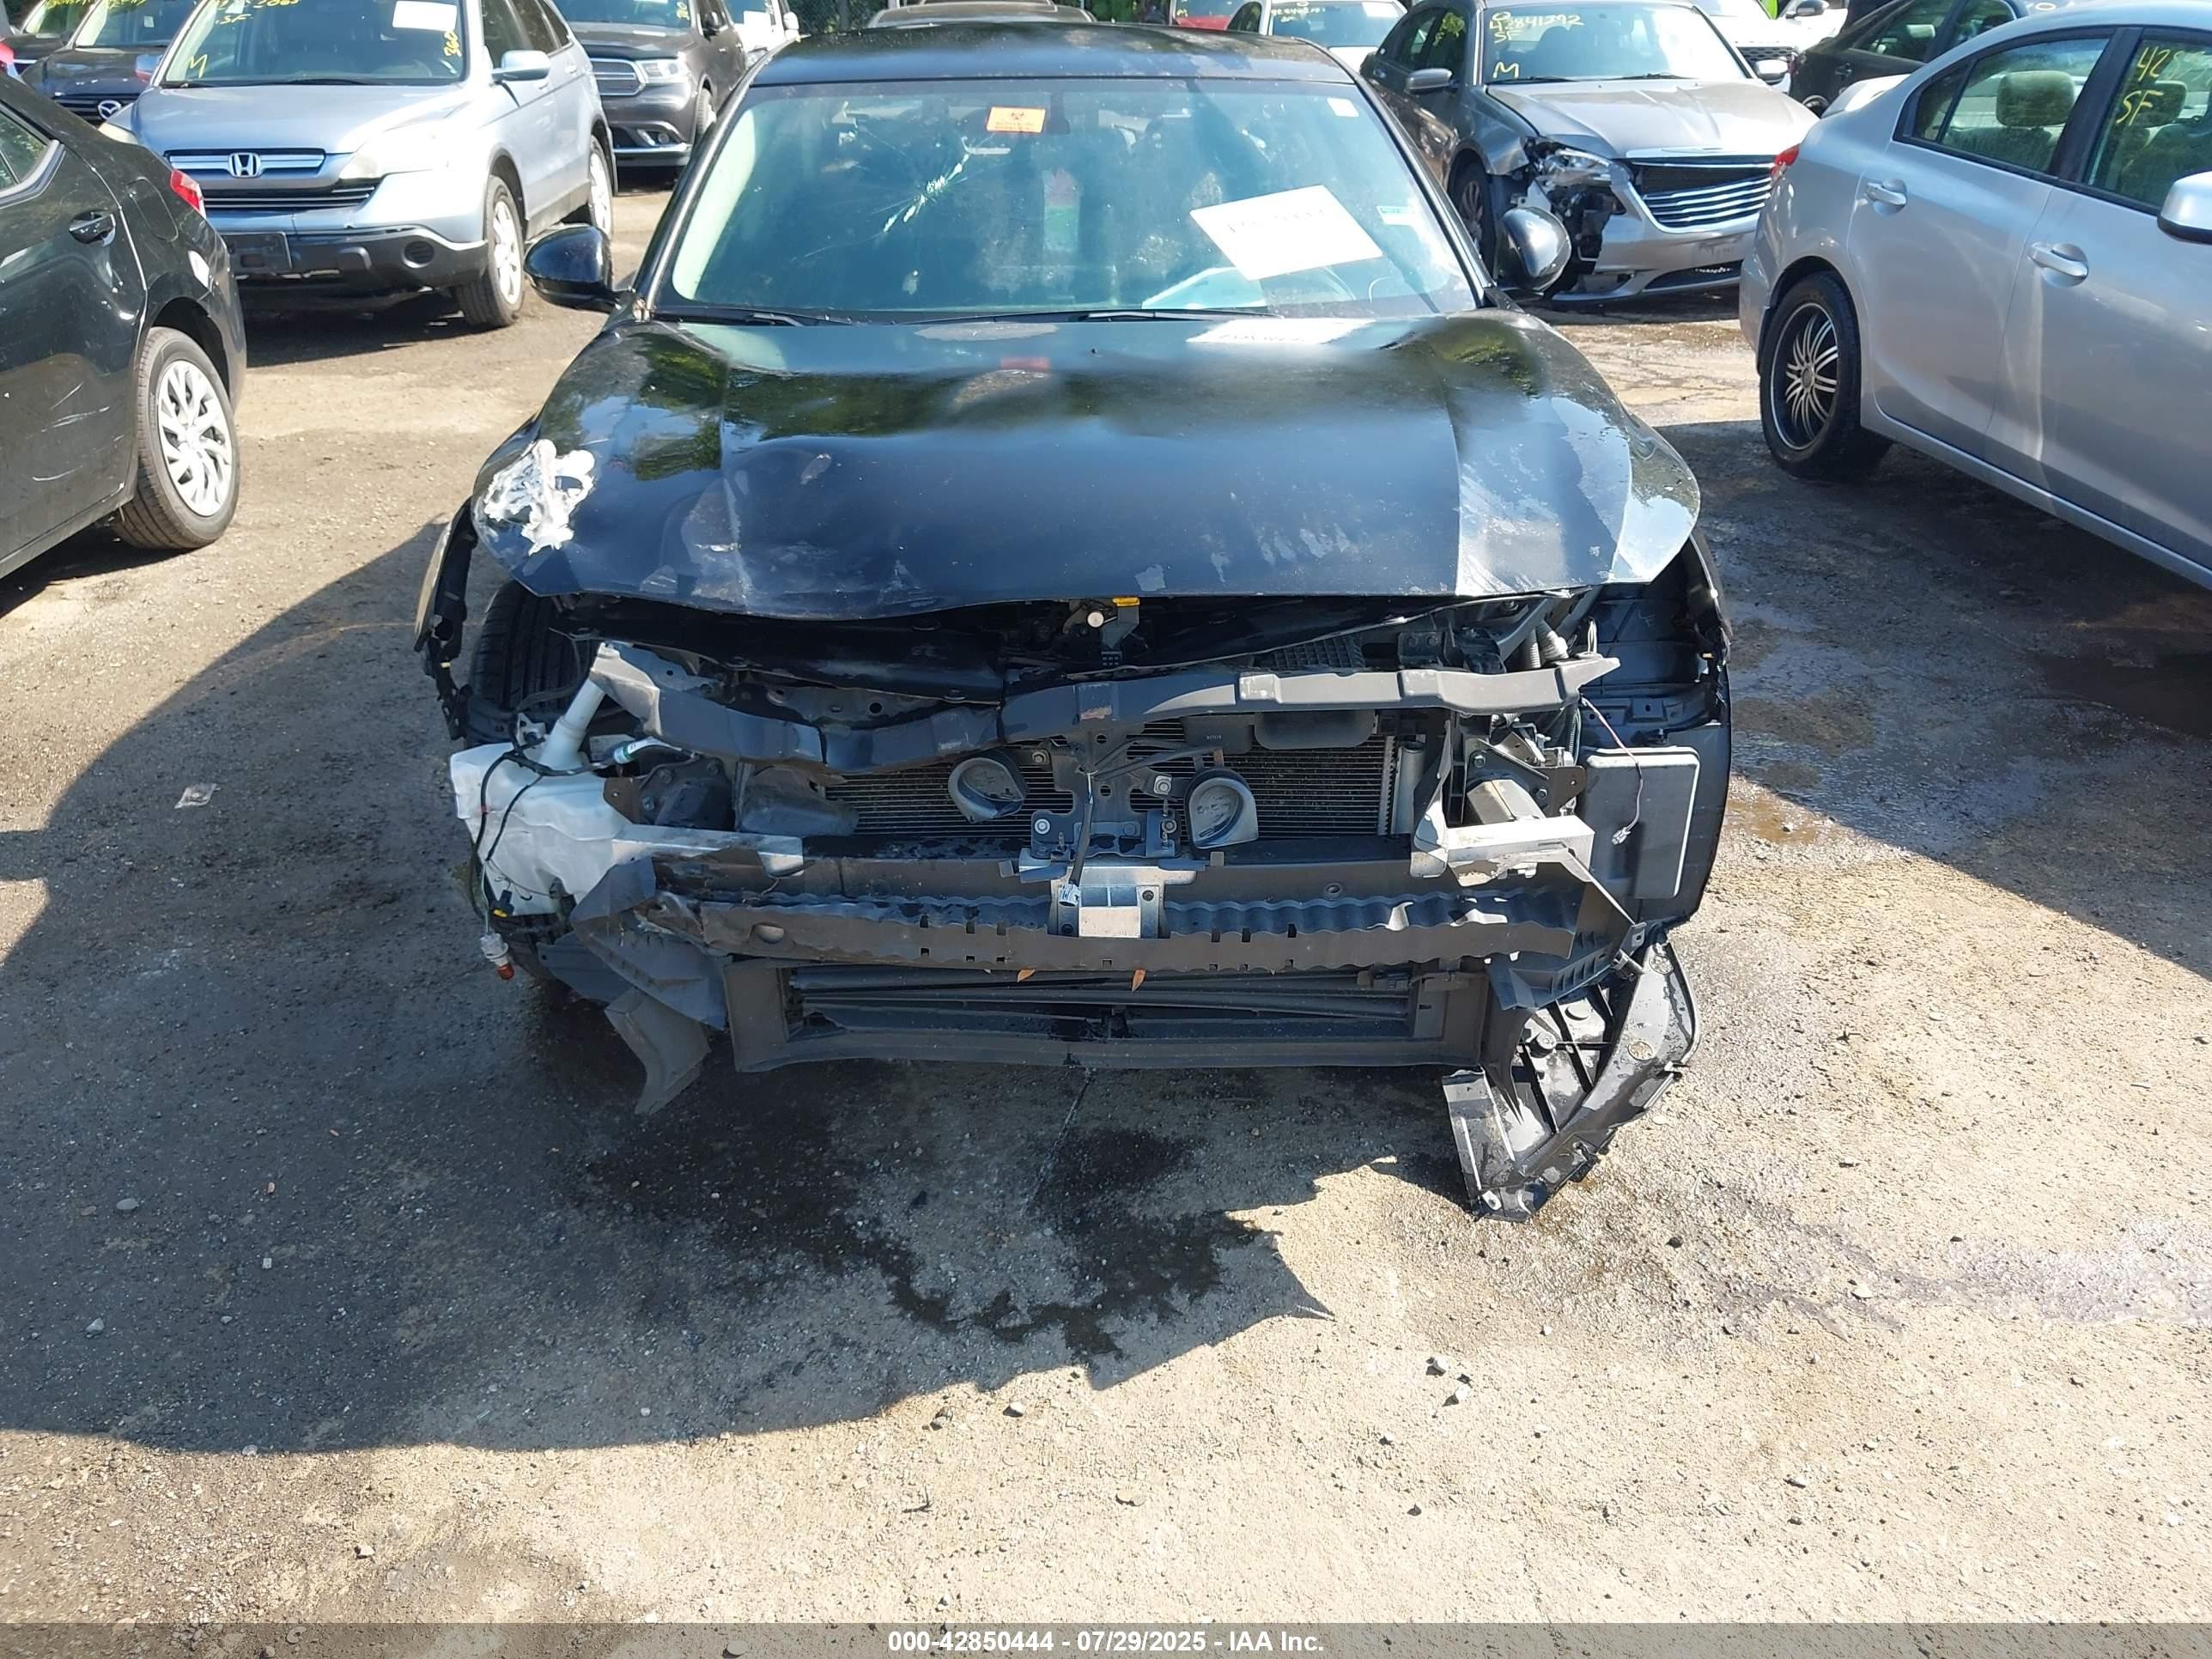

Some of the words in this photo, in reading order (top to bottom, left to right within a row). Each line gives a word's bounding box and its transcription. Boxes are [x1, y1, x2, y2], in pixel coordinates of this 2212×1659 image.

[185, 54, 208, 79] M
[1492, 62, 1519, 79] M
[2116, 89, 2164, 127] SF
